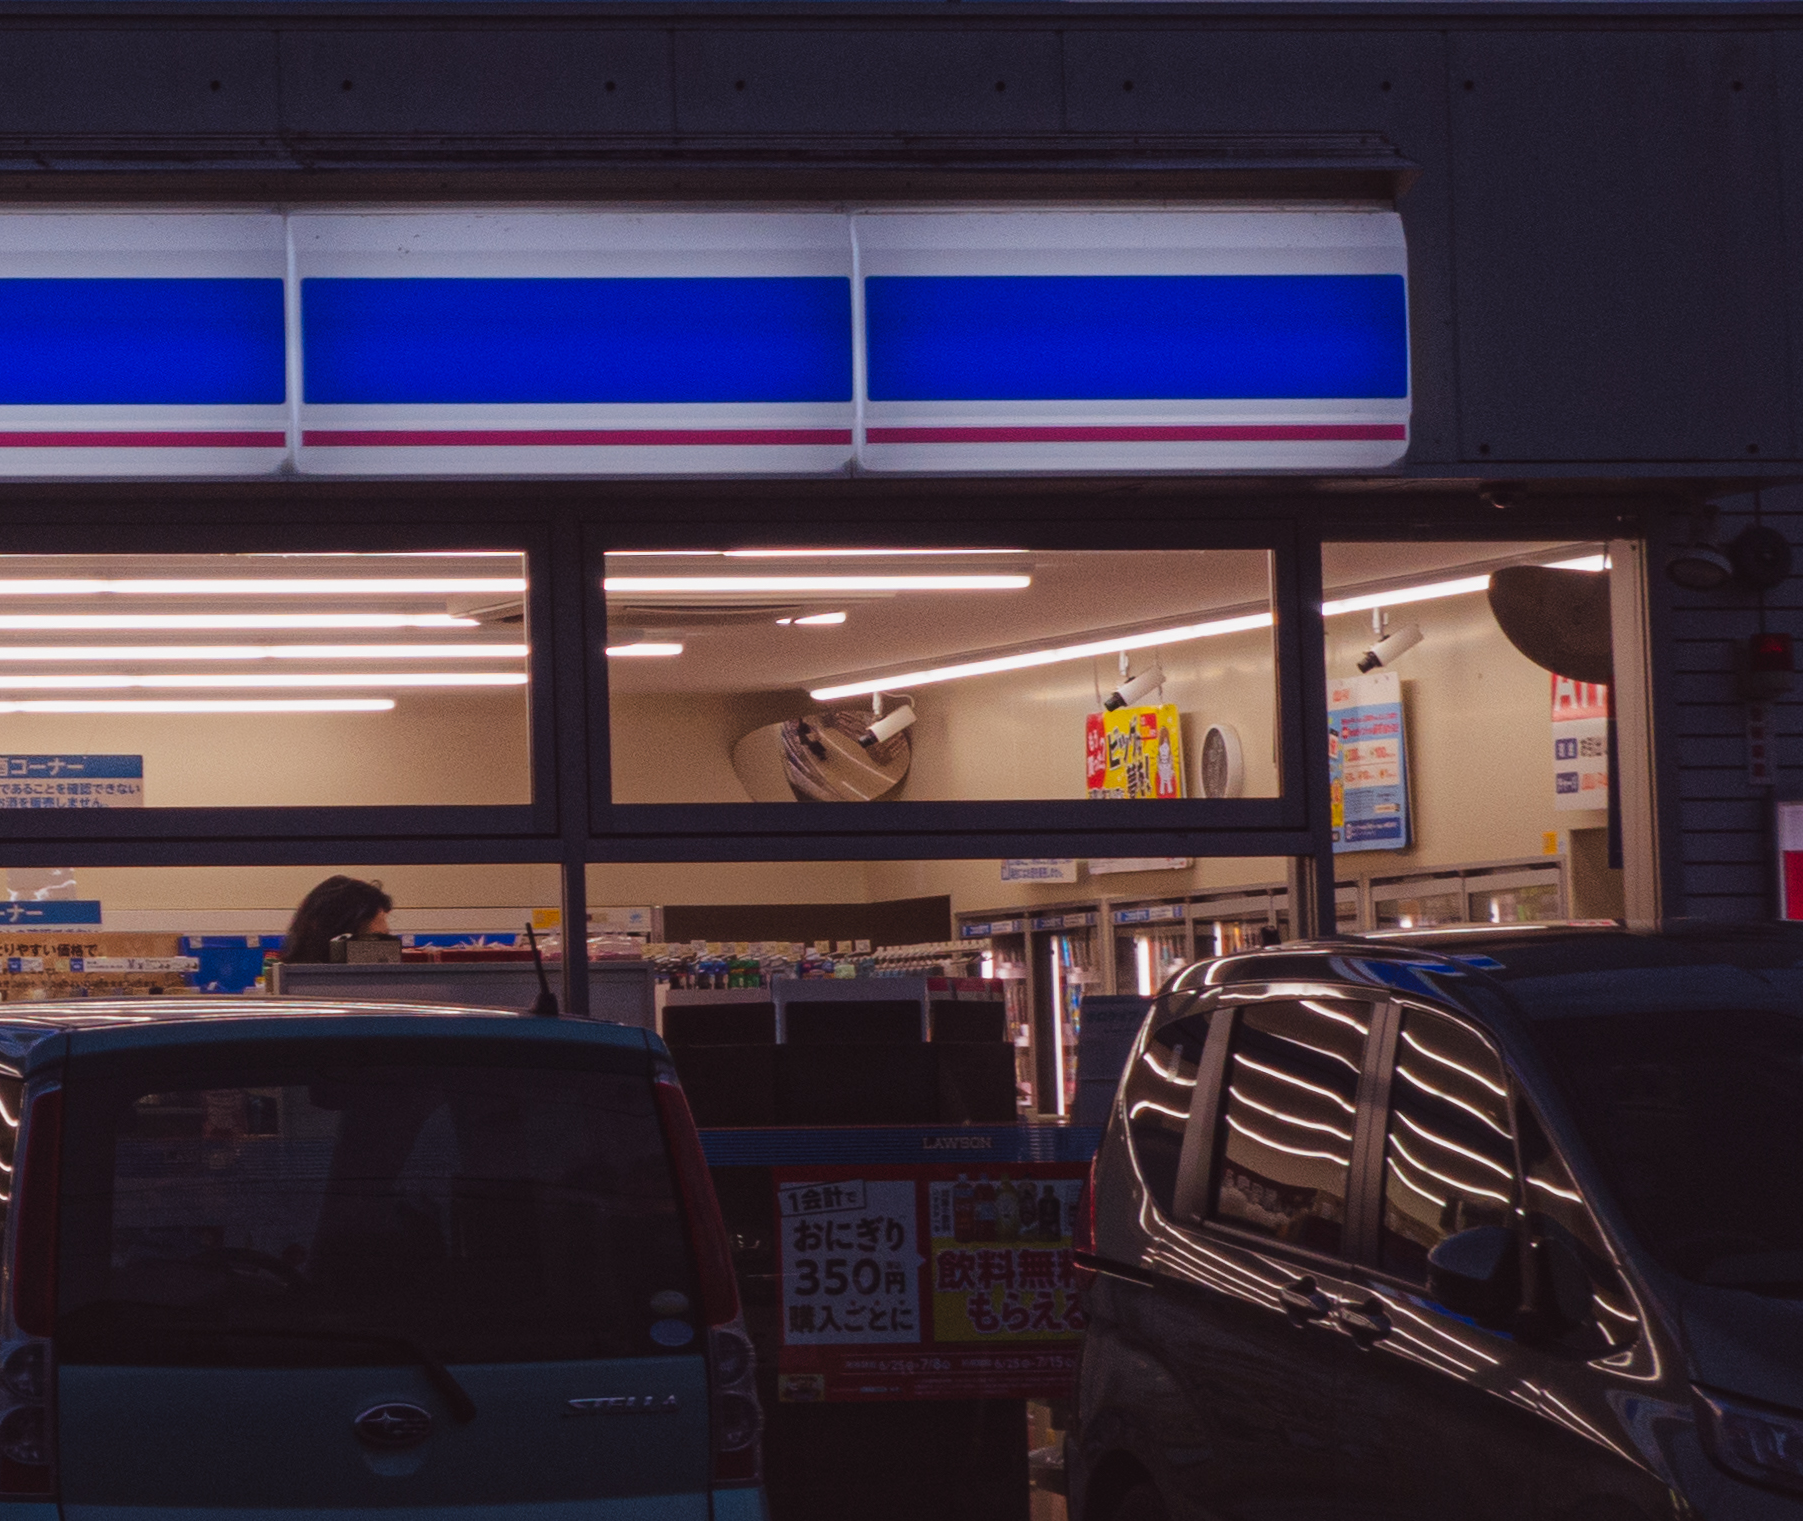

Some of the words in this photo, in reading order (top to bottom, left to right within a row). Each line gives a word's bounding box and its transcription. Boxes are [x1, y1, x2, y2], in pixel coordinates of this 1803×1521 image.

[922, 1136, 993, 1151] LAWSON
[793, 1217, 905, 1252] おにぎり
[794, 1258, 907, 1297] 350円
[789, 1304, 914, 1334] 購入ごとに
